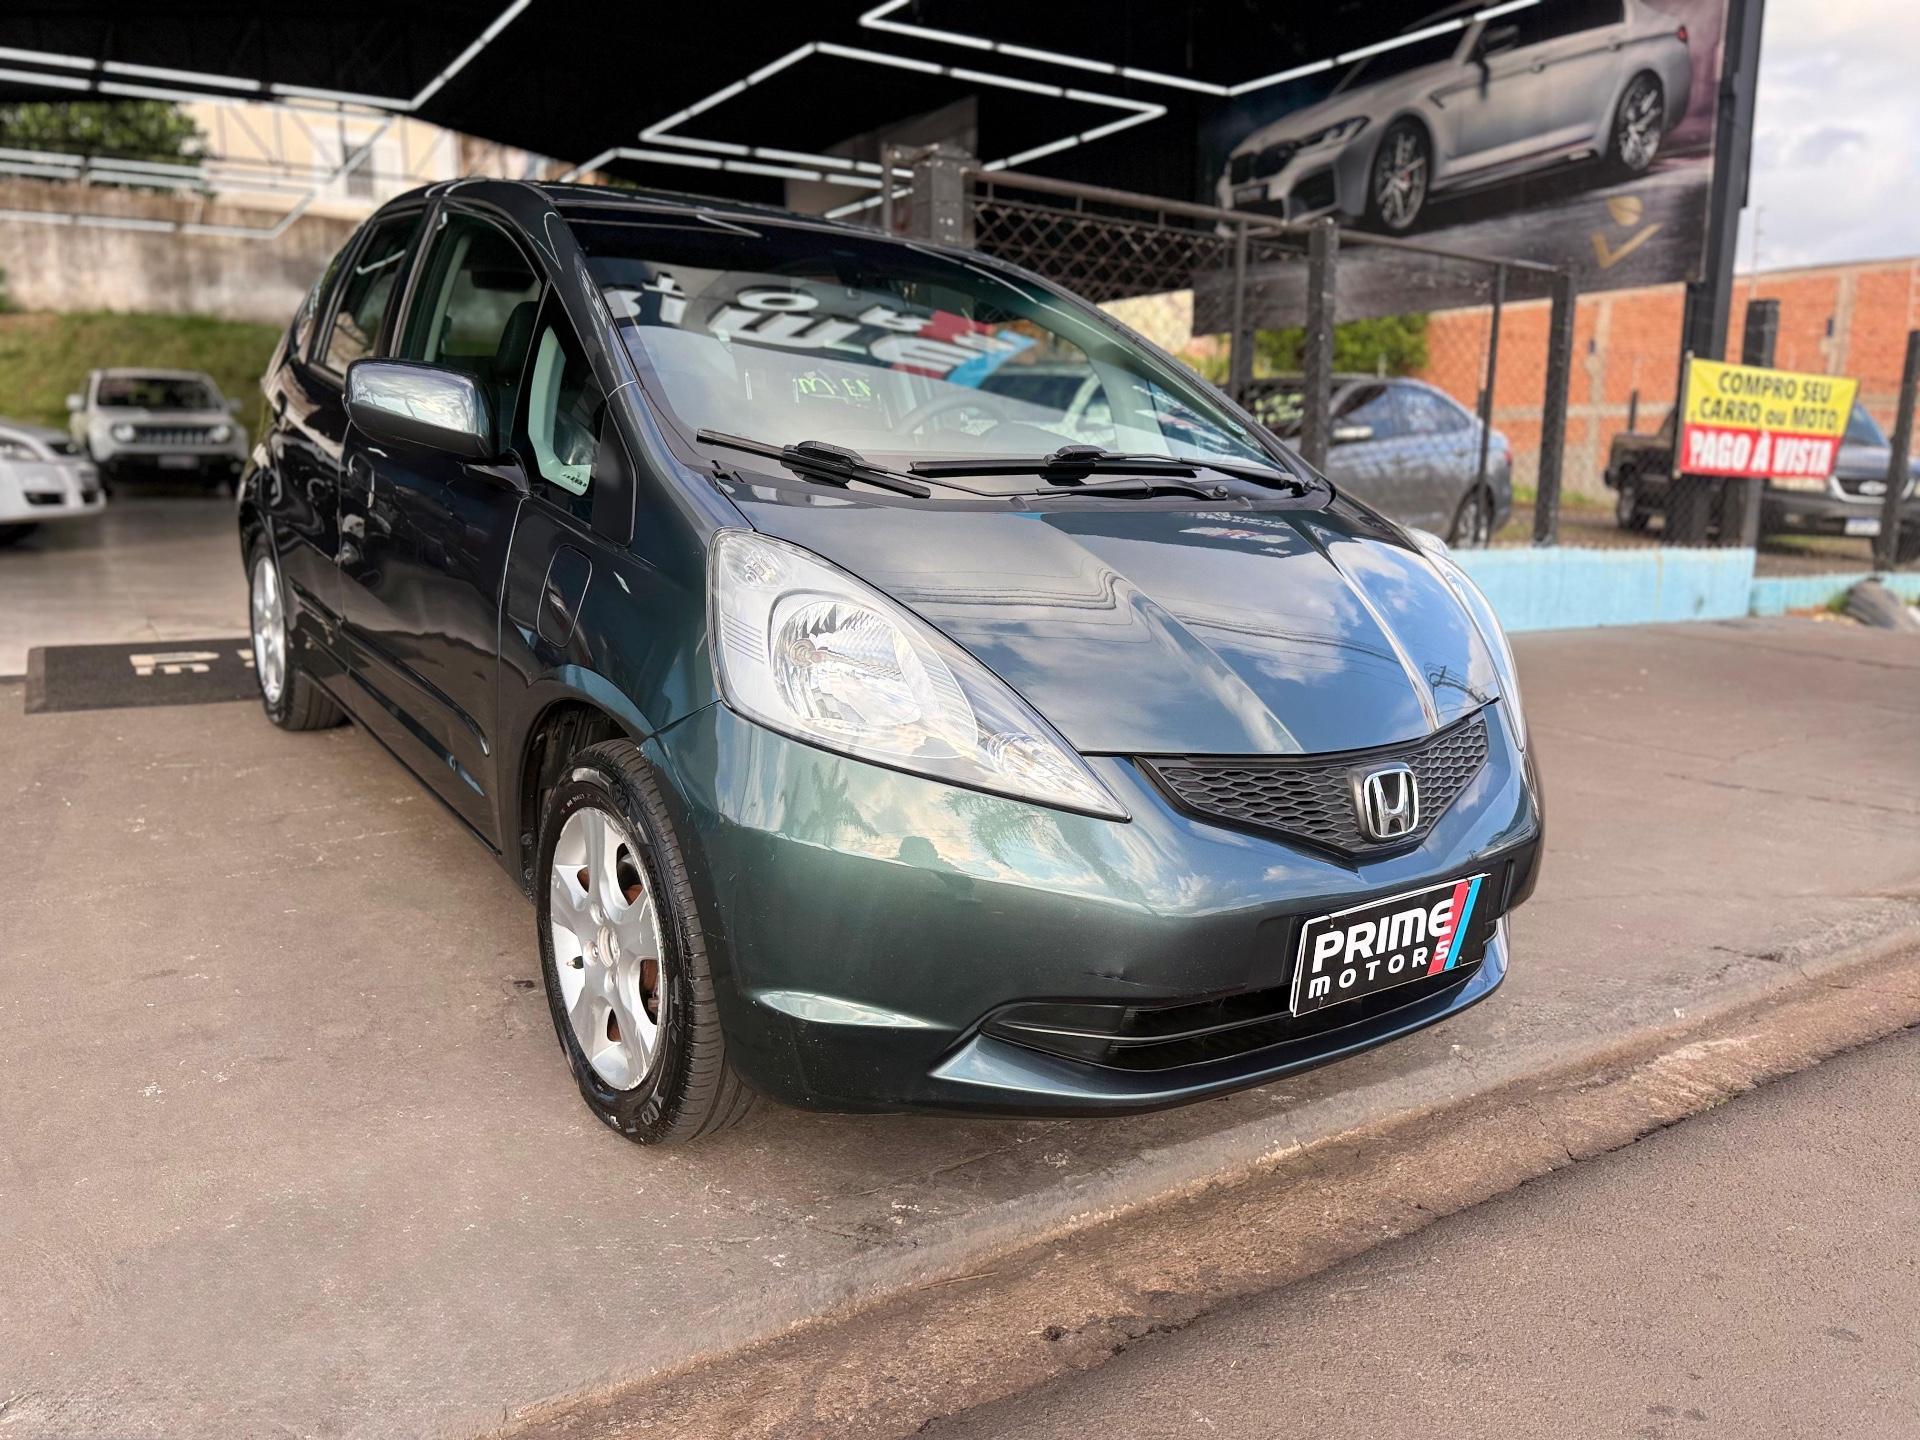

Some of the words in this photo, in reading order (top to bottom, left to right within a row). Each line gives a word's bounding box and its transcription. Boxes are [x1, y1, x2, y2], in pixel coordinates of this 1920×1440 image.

[1718, 371, 1798, 400] COMPRO
[1802, 380, 1832, 403] SEU
[1699, 397, 1761, 423] CARRO
[1765, 408, 1788, 426] ou
[1792, 405, 1838, 430] MOTO
[1688, 429, 1752, 472] PAGO
[1750, 430, 1771, 472] À
[1772, 436, 1833, 476] VISTA
[1311, 898, 1455, 974] PRIME
[1308, 939, 1450, 1000] MOTORS
